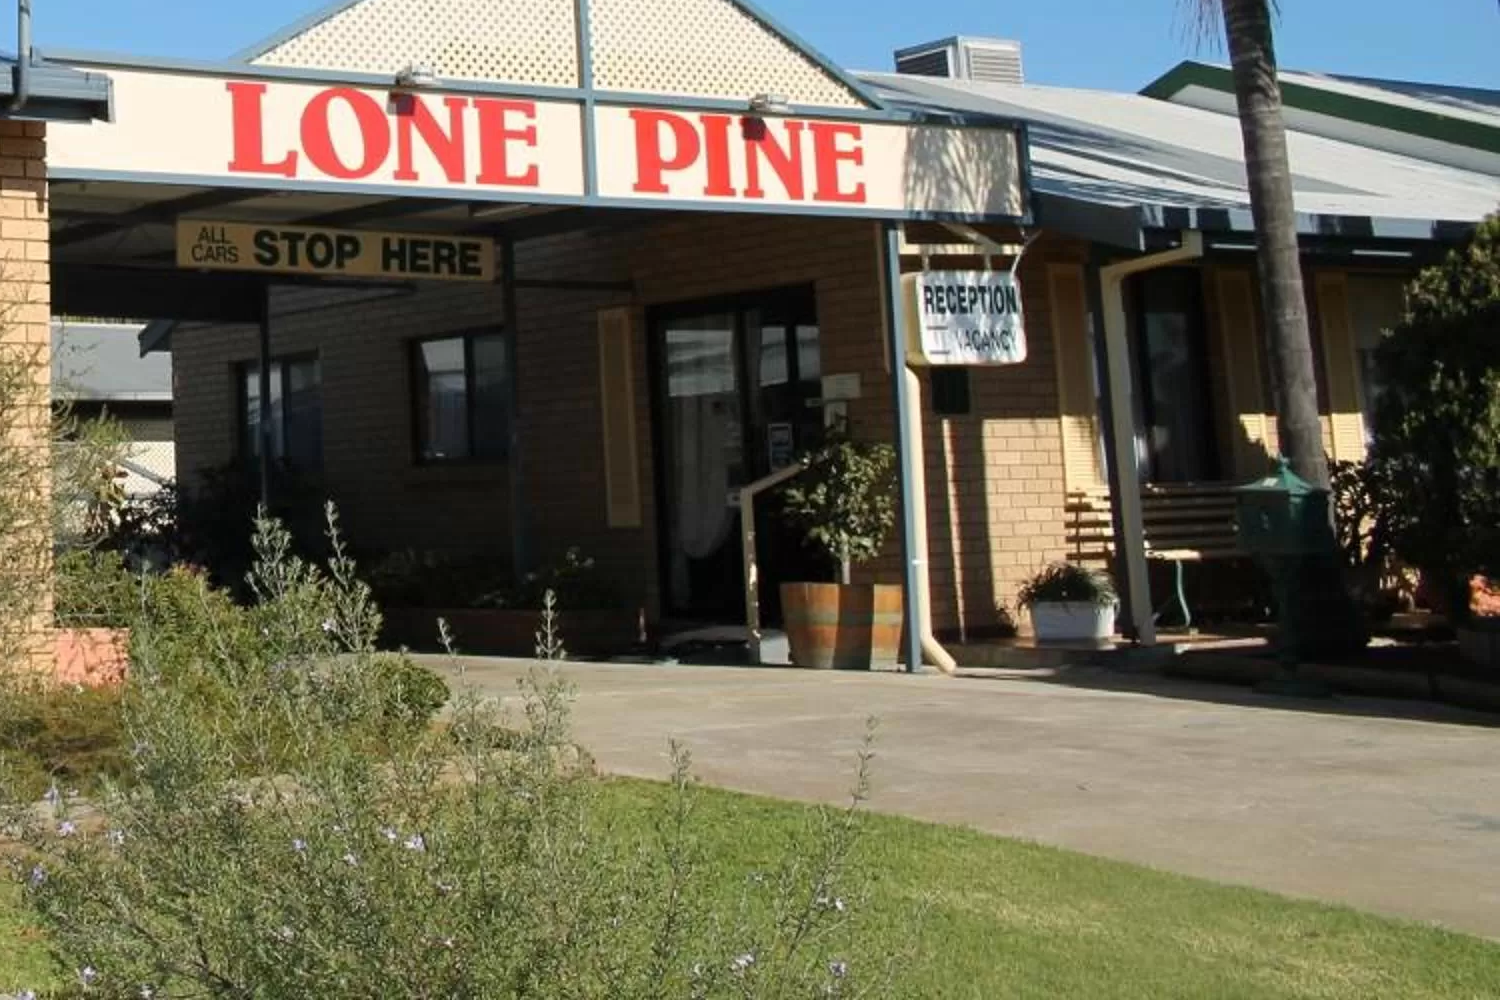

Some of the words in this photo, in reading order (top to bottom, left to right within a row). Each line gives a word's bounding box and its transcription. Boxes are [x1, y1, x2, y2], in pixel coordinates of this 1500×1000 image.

[226, 81, 539, 187] LONE
[628, 108, 866, 204] PINE
[198, 226, 231, 245] ALL
[191, 245, 240, 264] CARS
[253, 229, 362, 269] STOP
[381, 236, 484, 276] HERE
[924, 284, 1017, 315] RECEPTION
[954, 328, 1016, 351] VACANCY
